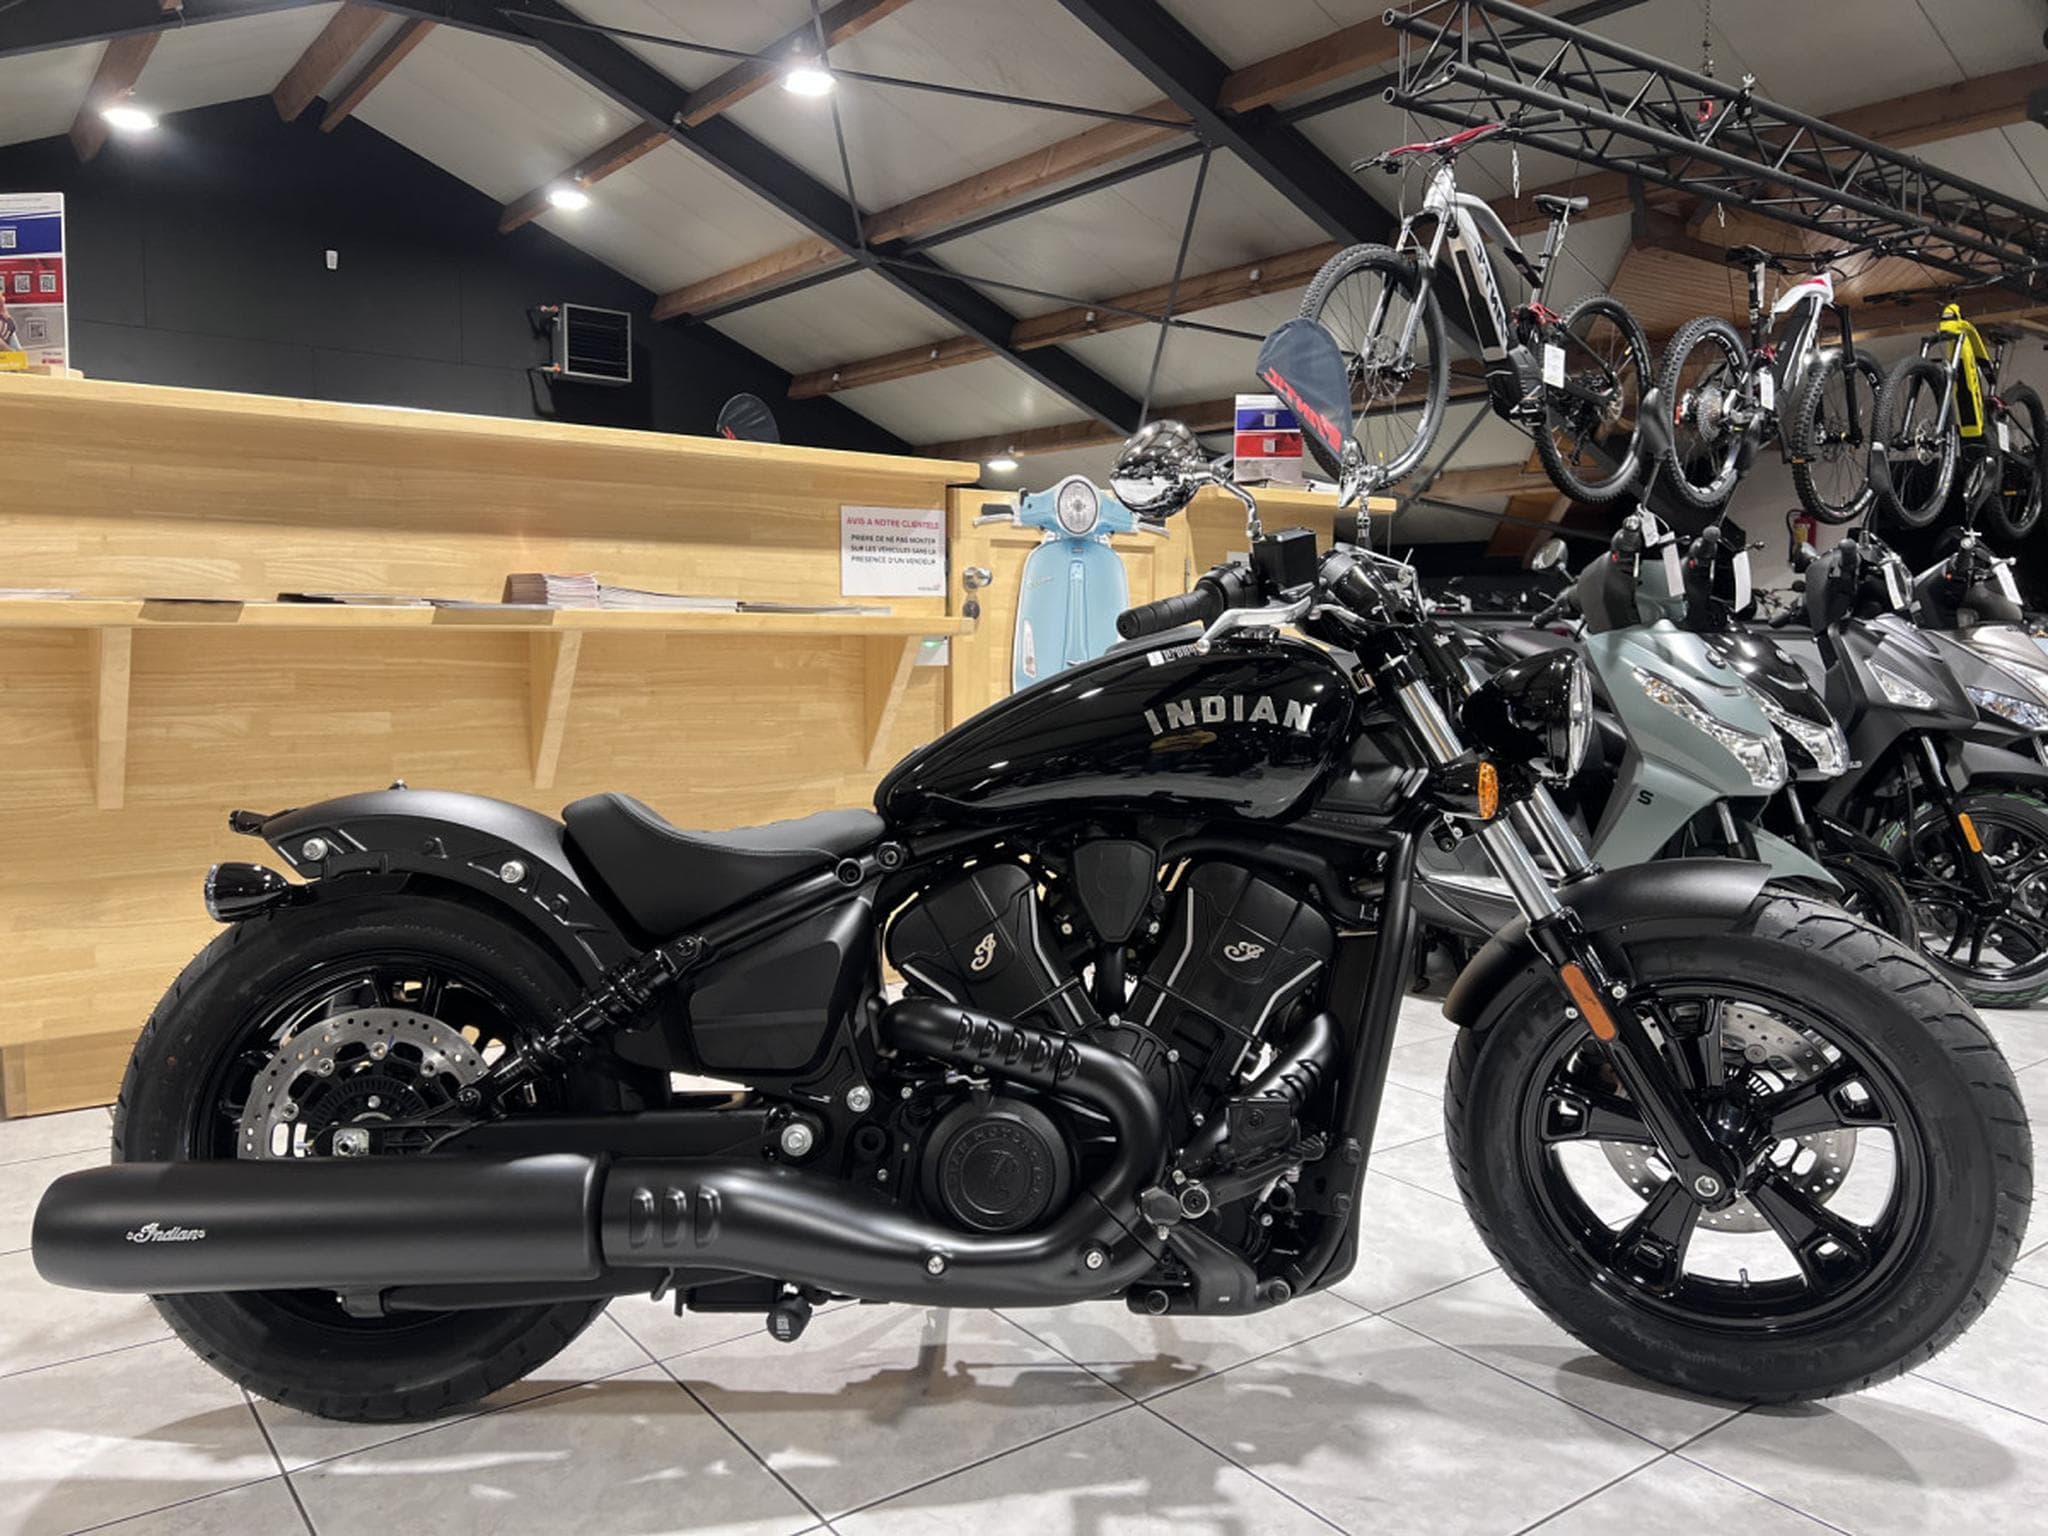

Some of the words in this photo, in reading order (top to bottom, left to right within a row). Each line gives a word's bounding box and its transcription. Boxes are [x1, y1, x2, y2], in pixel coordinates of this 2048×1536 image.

[846, 517, 866, 526] AVIS
[866, 518, 873, 526] A
[875, 518, 901, 528] NOTRE
[850, 534, 874, 542] PRIERE
[885, 535, 895, 543] NE
[877, 546, 911, 554] VEHICULES
[851, 556, 886, 564] PRESENCE
[887, 557, 905, 565] D'UN
[905, 558, 936, 566] VENDEUR
[1144, 694, 1314, 736] INDIAN
[1637, 789, 1655, 806] S
[132, 1222, 200, 1244] Indian
